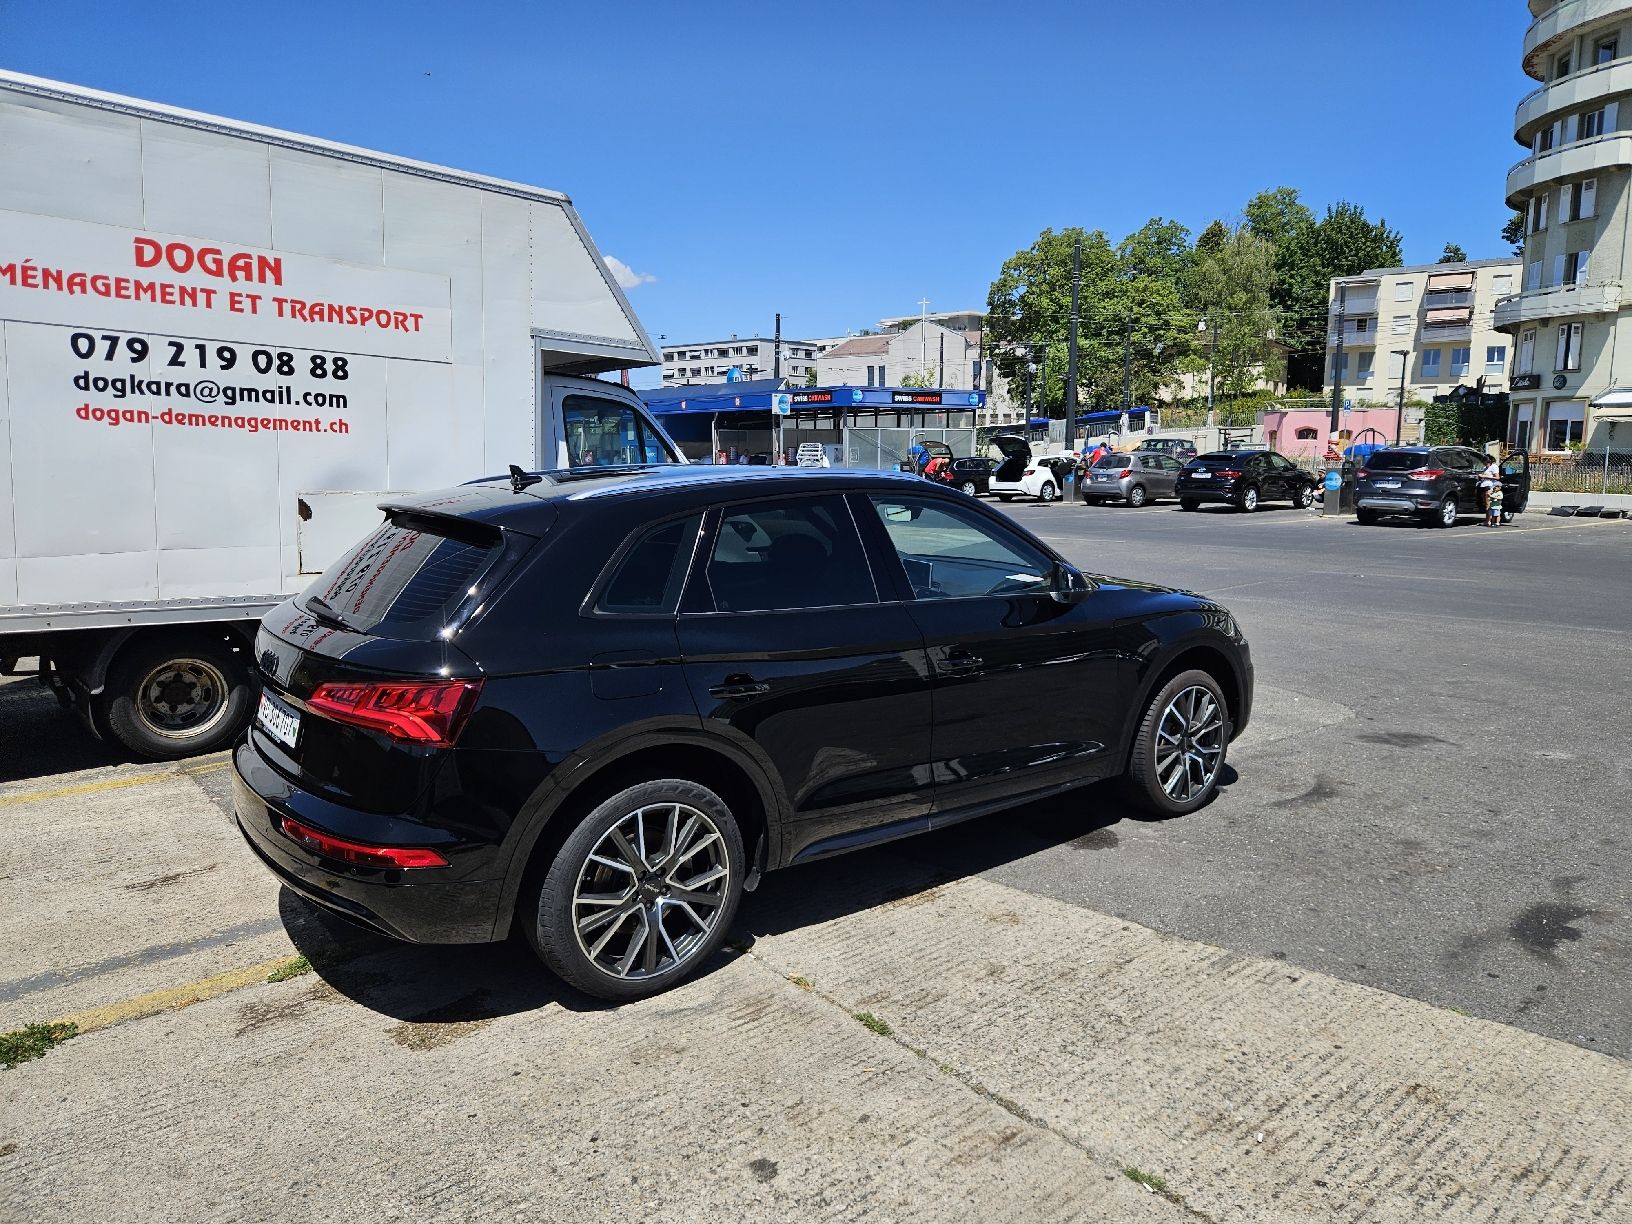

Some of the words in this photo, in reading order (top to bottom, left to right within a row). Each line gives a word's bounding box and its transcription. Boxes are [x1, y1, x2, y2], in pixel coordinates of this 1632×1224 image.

[134, 237, 283, 286] DOGAN
[0, 258, 217, 309] MÉNAGEMENT
[229, 291, 262, 314] ET
[272, 296, 423, 333] TRANSPORT
[70, 332, 150, 363] 079
[167, 340, 237, 371] 219
[251, 349, 295, 376] 08
[309, 354, 349, 380] 88
[73, 370, 348, 409] dogkara@gmail.com
[75, 403, 349, 433] dogan-demenagement.ch
